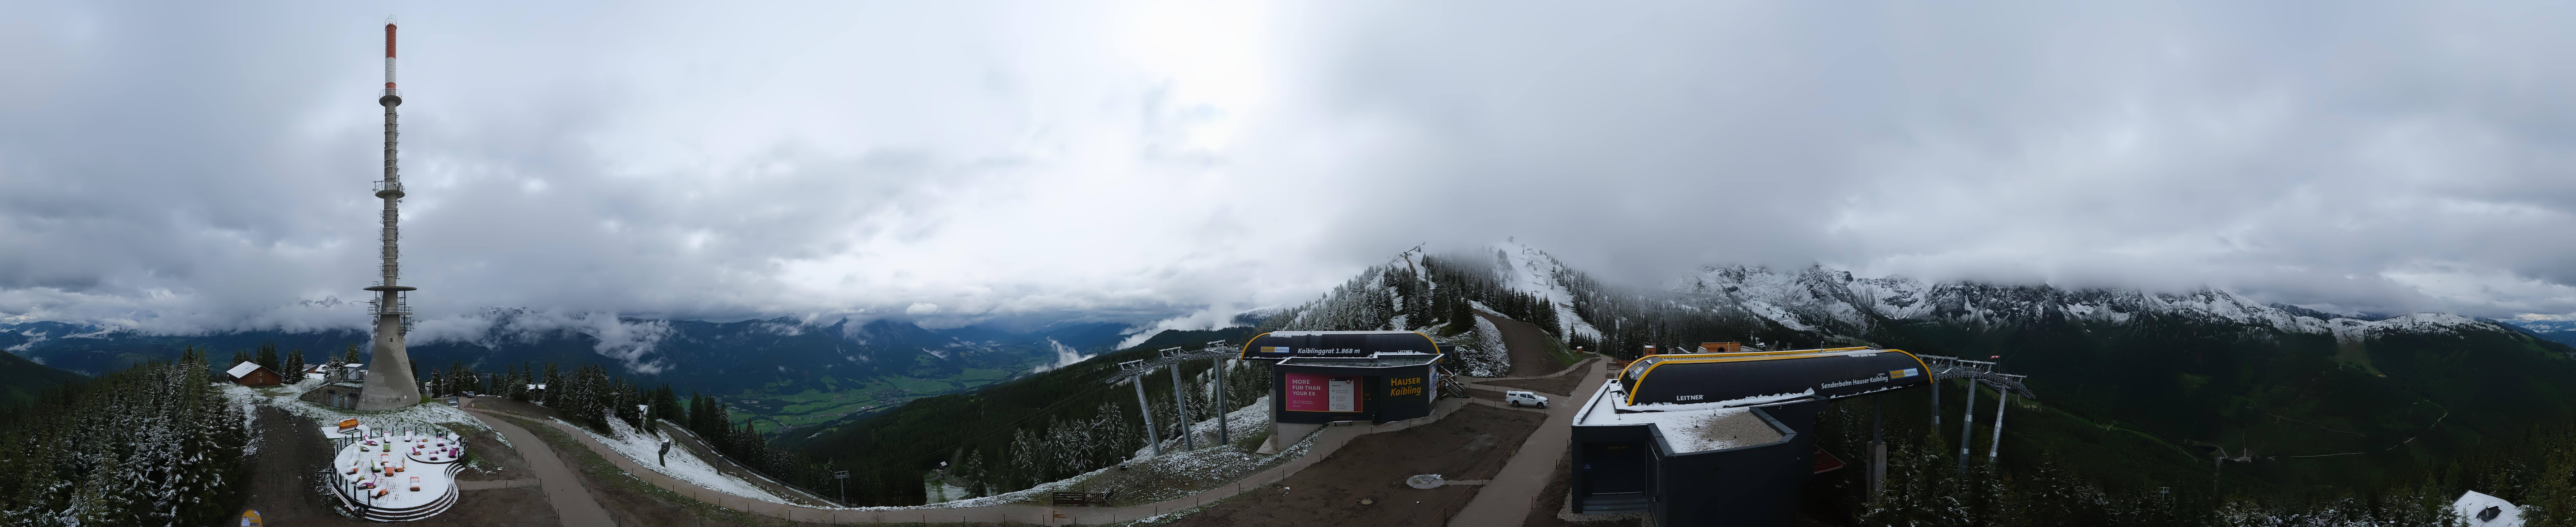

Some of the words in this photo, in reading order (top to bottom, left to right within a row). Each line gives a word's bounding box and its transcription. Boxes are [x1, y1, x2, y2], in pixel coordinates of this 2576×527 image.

[1391, 377, 1421, 386] HAUSER
[1821, 381, 1852, 389] Senderbahn
[1391, 386, 1421, 396] Kaibling
